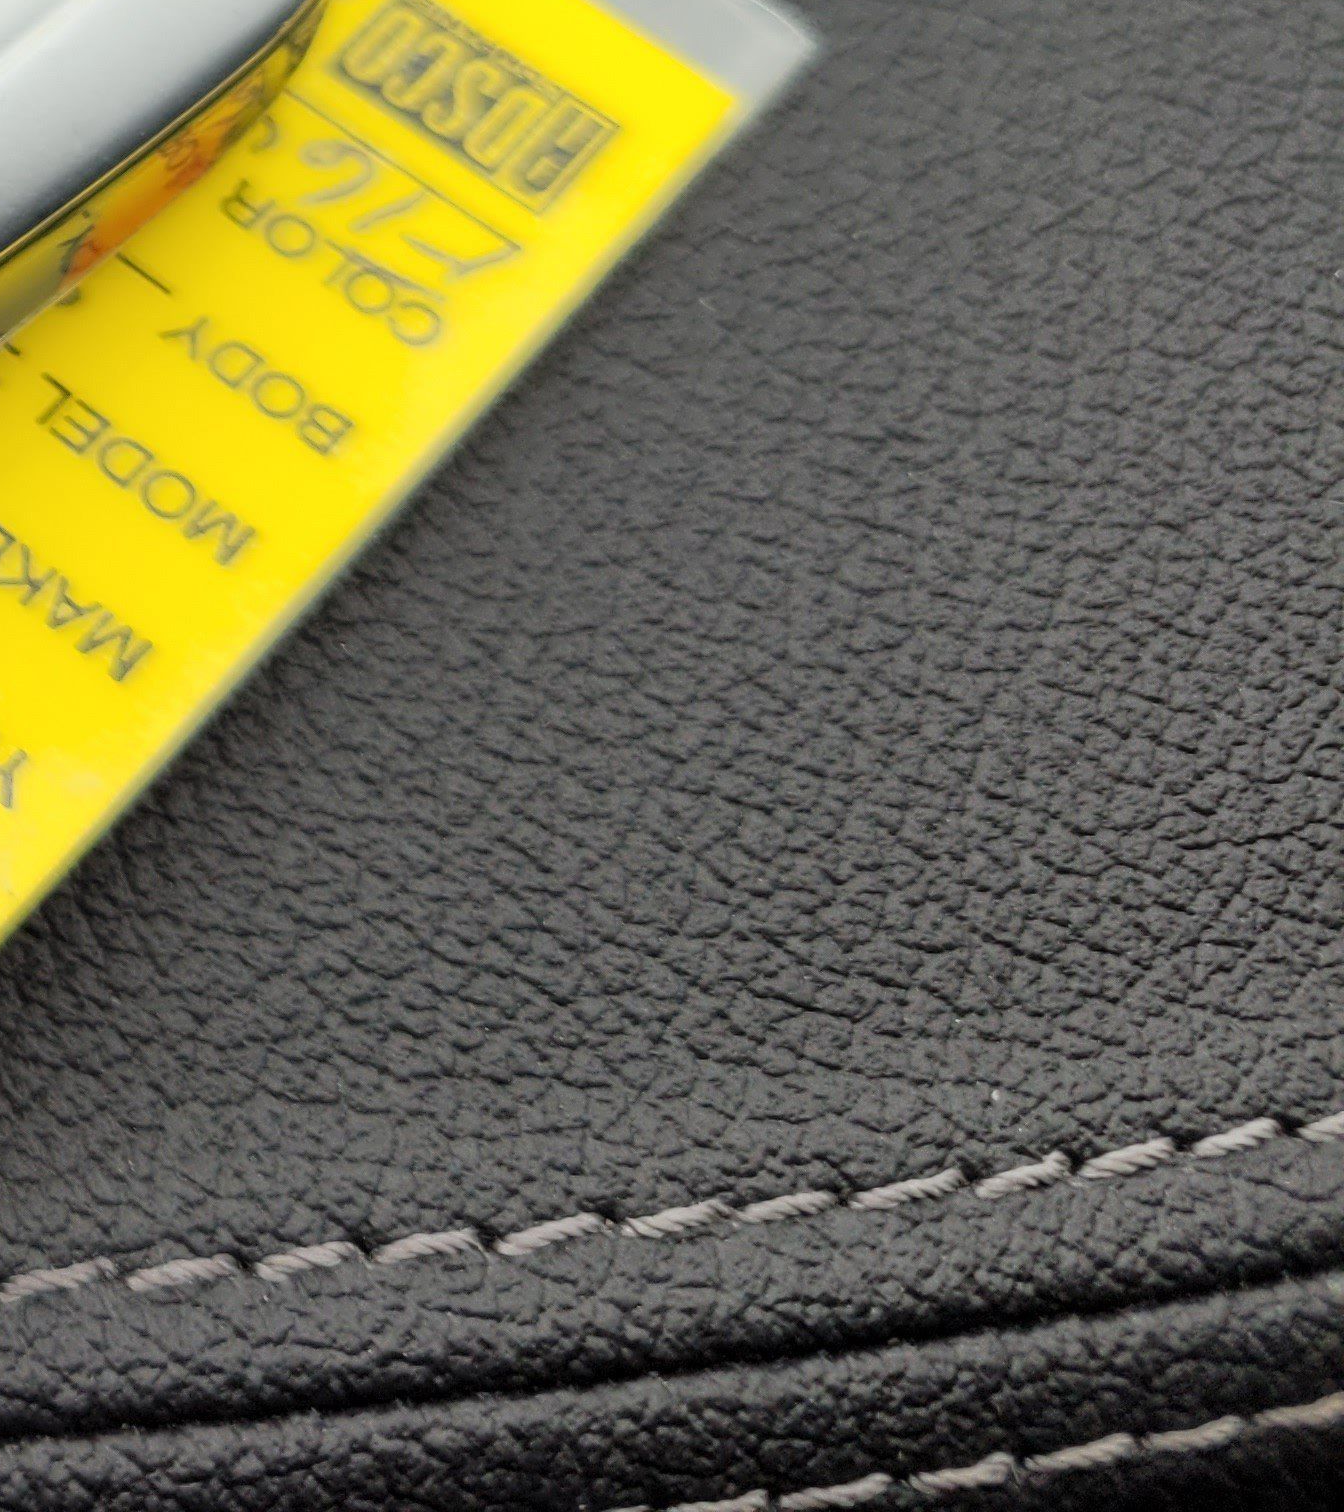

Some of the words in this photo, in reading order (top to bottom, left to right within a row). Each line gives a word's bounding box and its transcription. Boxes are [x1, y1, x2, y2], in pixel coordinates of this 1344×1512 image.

[220, 178, 444, 347] COLOR
[32, 370, 256, 566] MODEL
[159, 314, 356, 457] BODY
